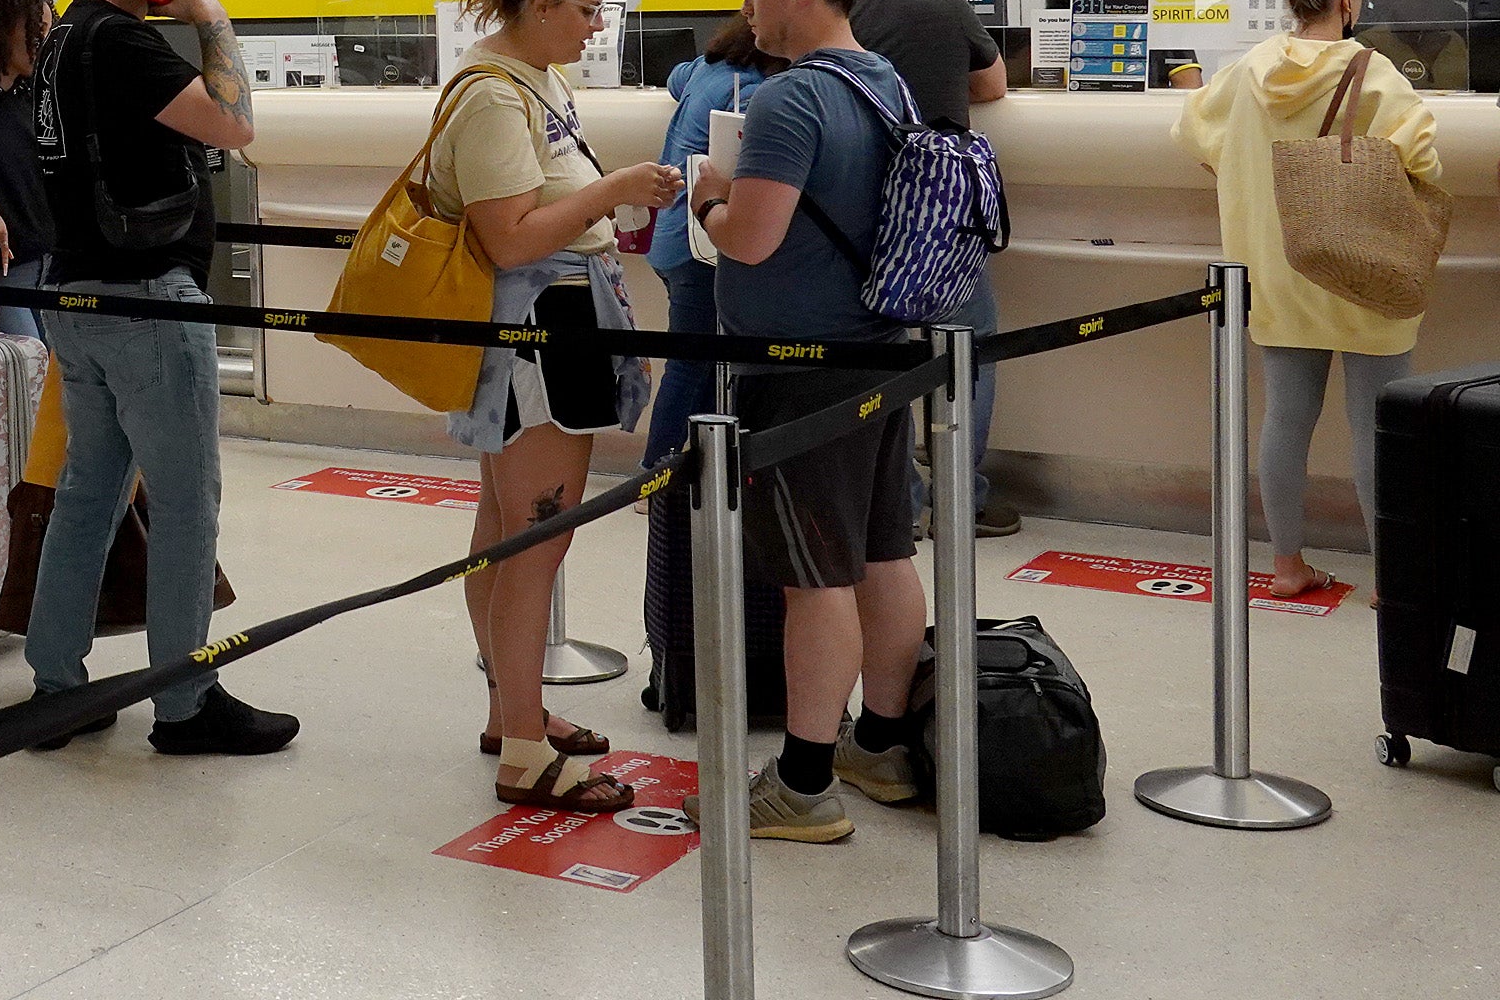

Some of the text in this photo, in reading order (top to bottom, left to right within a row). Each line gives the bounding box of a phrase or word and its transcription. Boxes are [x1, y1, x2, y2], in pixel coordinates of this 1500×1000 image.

[1153, 8, 1230, 21] SPIRIT.COM
[335, 233, 355, 245] spi
[59, 293, 99, 311] spirit
[1200, 287, 1222, 308] spirit
[263, 312, 309, 329] spirit
[1078, 316, 1104, 338] spirit
[498, 327, 550, 344] spirit
[767, 343, 827, 361] spirit
[858, 391, 882, 420] spirit
[331, 469, 375, 479] Thank
[381, 473, 410, 482] You
[410, 477, 435, 485] For
[347, 476, 391, 486] Social
[392, 480, 480, 494] Distancing
[639, 466, 673, 500] spirit
[1058, 553, 1212, 576] Thank You For
[1089, 563, 1150, 576] Social
[189, 630, 250, 664] spirit
[468, 808, 558, 853] Thank You
[529, 816, 589, 845] Social
